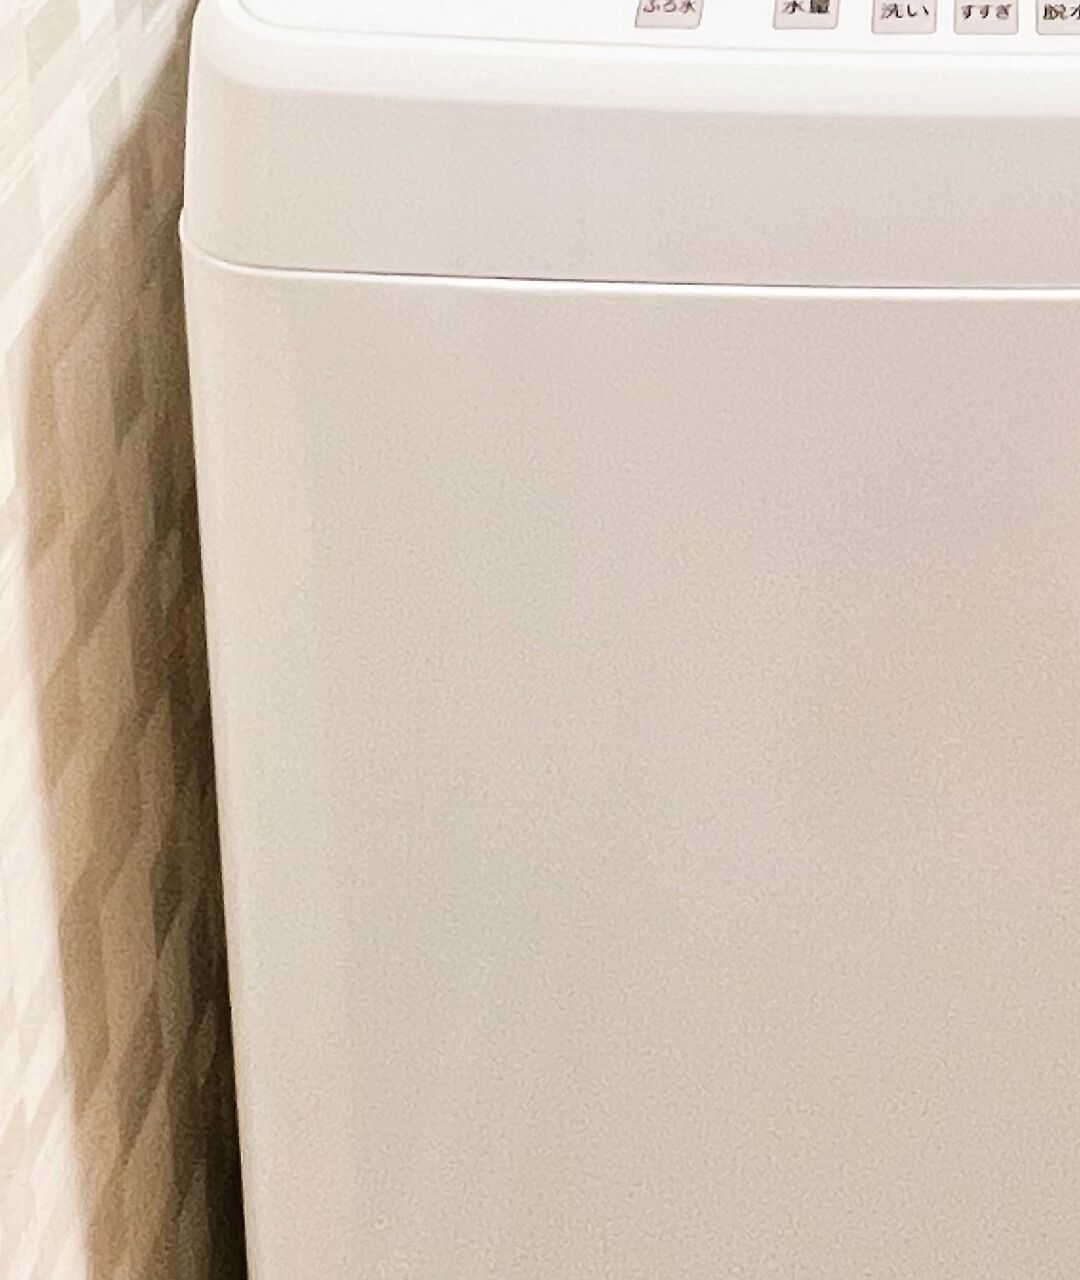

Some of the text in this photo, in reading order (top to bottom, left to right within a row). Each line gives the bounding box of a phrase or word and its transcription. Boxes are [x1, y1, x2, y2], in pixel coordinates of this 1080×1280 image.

[880, 2, 930, 20] 洗い
[961, 3, 1013, 20] すすぎ
